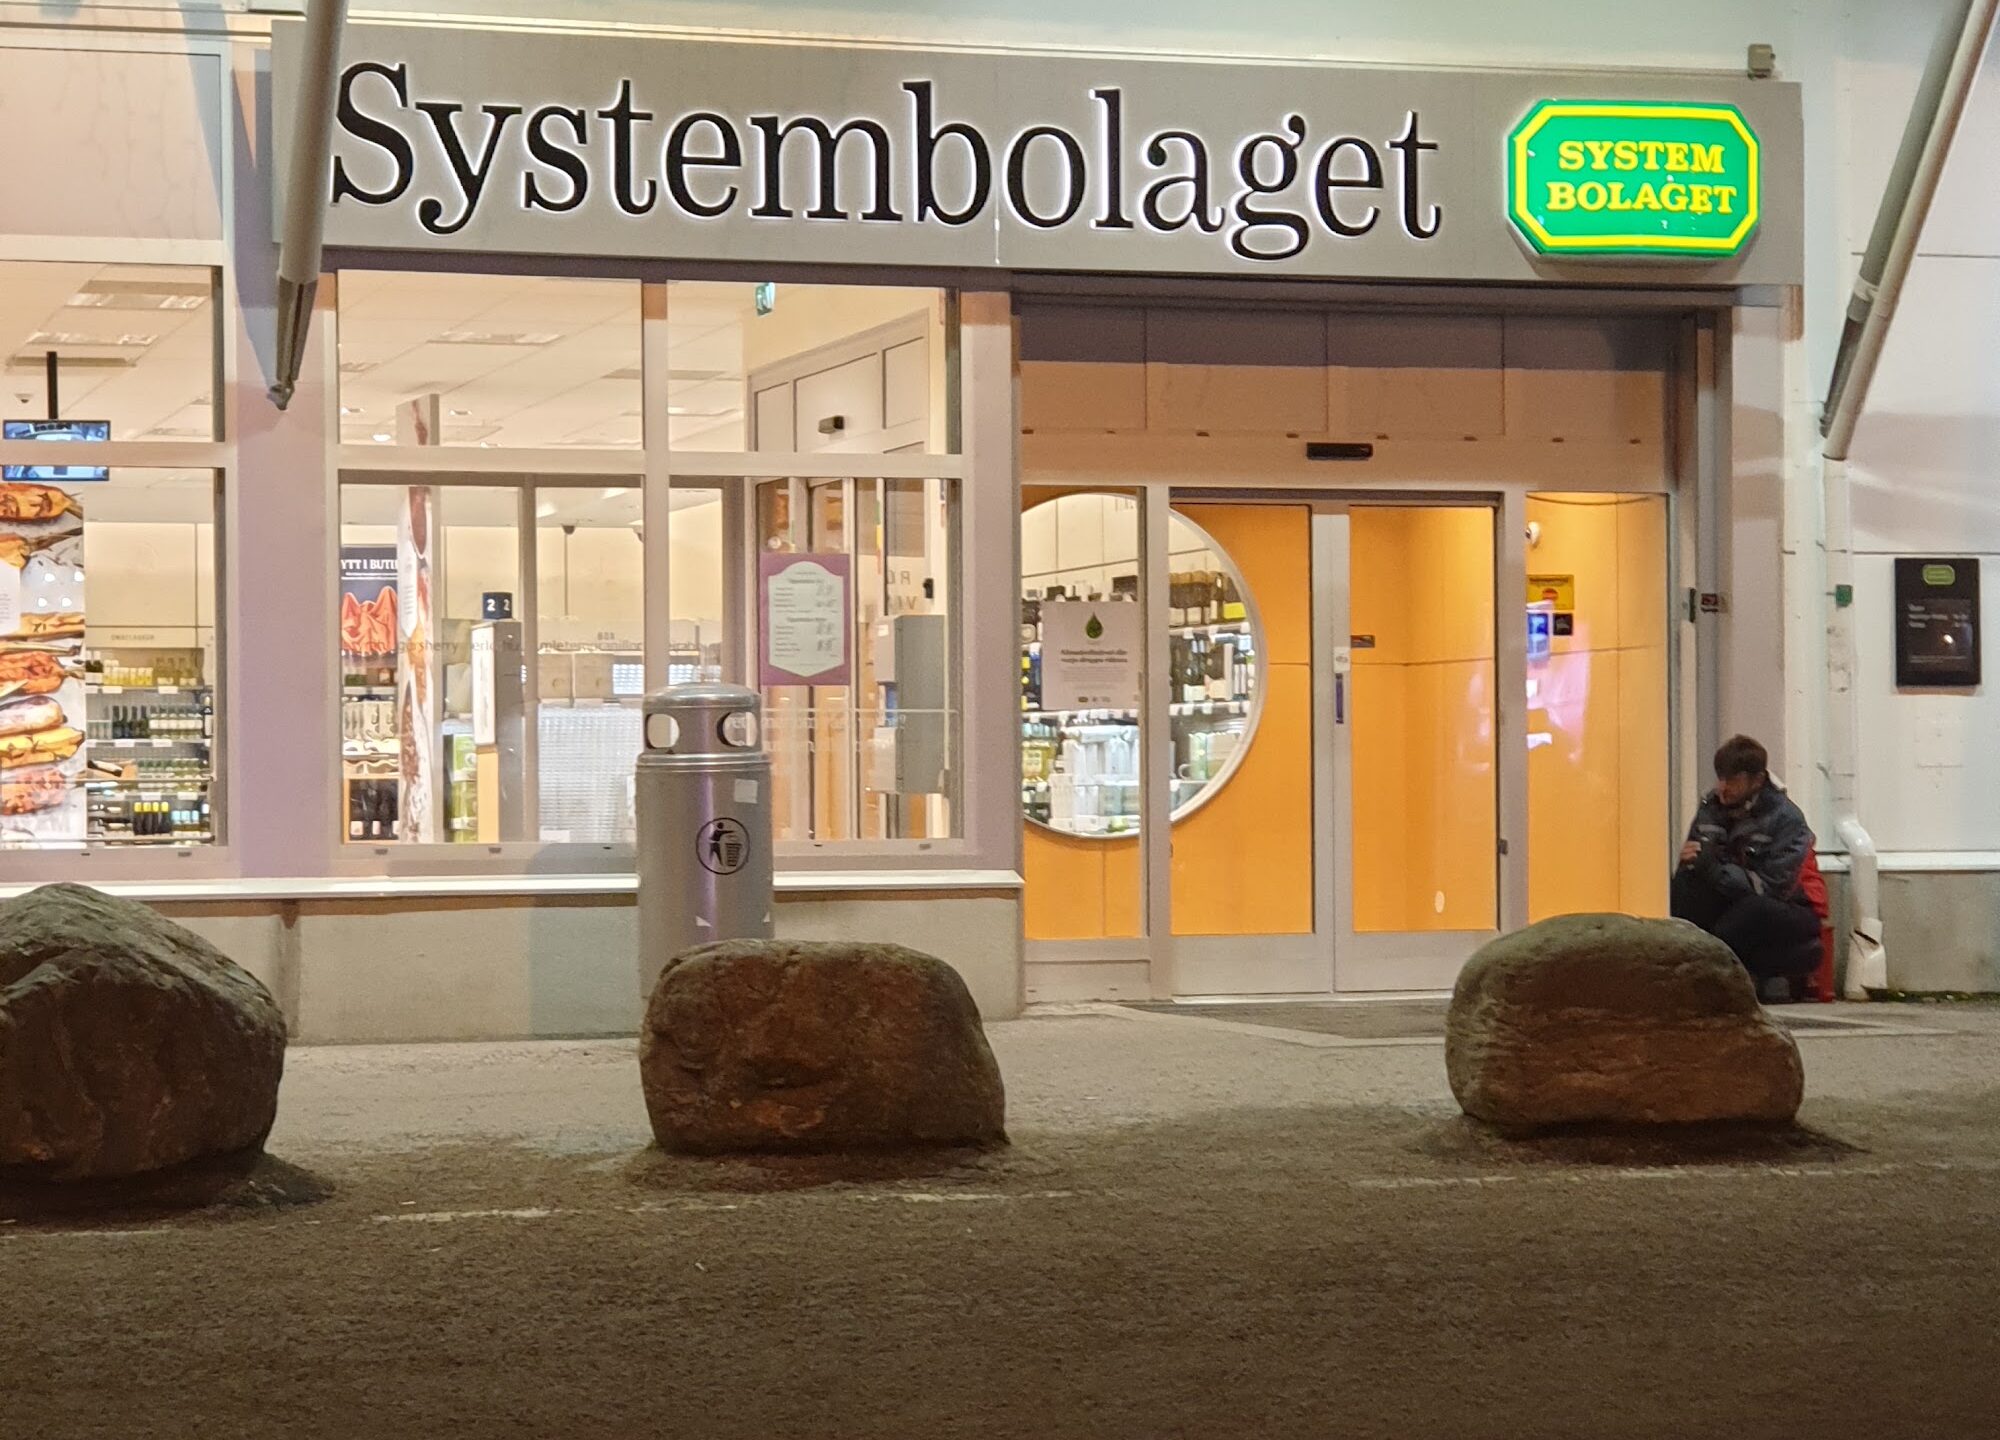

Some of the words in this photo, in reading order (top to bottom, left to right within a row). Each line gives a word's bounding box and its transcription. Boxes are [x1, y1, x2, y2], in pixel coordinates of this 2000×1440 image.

[331, 61, 1443, 260] Systembolaget
[1558, 140, 1725, 173] SYSTEM
[1545, 181, 1738, 214] BOLAGET
[341, 559, 362, 570] YTT
[487, 598, 496, 611] 2
